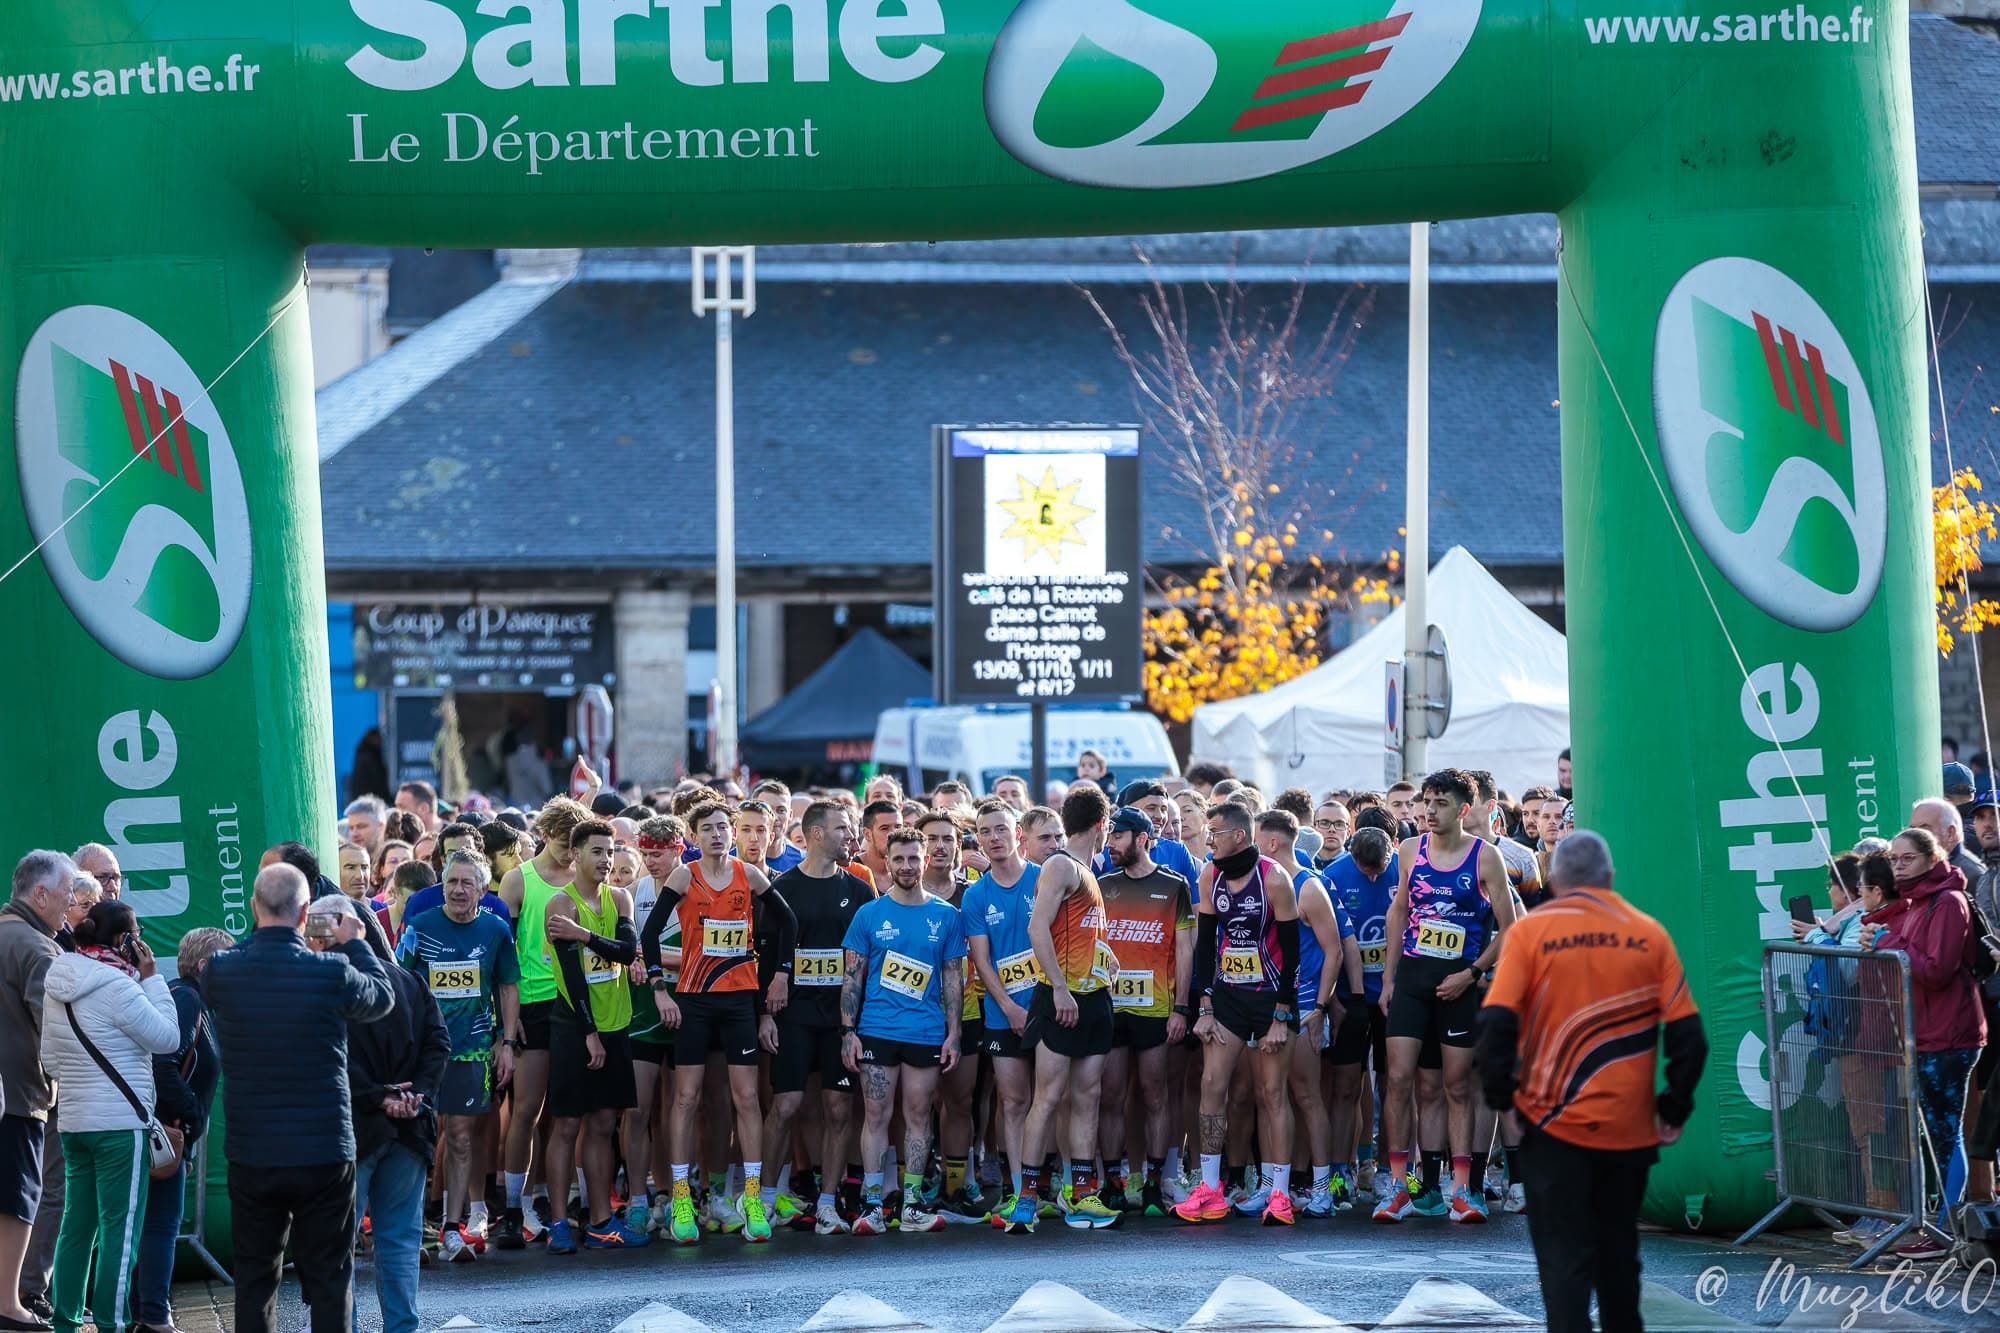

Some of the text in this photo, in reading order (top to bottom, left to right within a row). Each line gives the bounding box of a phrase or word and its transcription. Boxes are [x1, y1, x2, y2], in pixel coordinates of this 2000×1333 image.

[1584, 4, 1874, 44] www.sarthe.fr
[347, 112, 821, 175] Le Département
[1007, 586, 1031, 604] de
[1033, 585, 1050, 604] la
[1052, 585, 1124, 604] Rotonde
[990, 604, 1098, 625] place Carnot
[985, 622, 1106, 642] danse salle de
[1079, 658, 1113, 679] 1/11
[1016, 680, 1036, 697] et
[1432, 888, 1453, 896] TOURS
[710, 930, 744, 946] 147
[1106, 929, 1165, 944] ESNOISE
[1421, 928, 1459, 949] 210
[1542, 932, 1621, 955] MAMERS
[800, 958, 838, 975] 215
[886, 962, 925, 988] 279
[1002, 960, 1036, 984] 281
[1225, 957, 1256, 973] 284
[435, 970, 475, 988] 288
